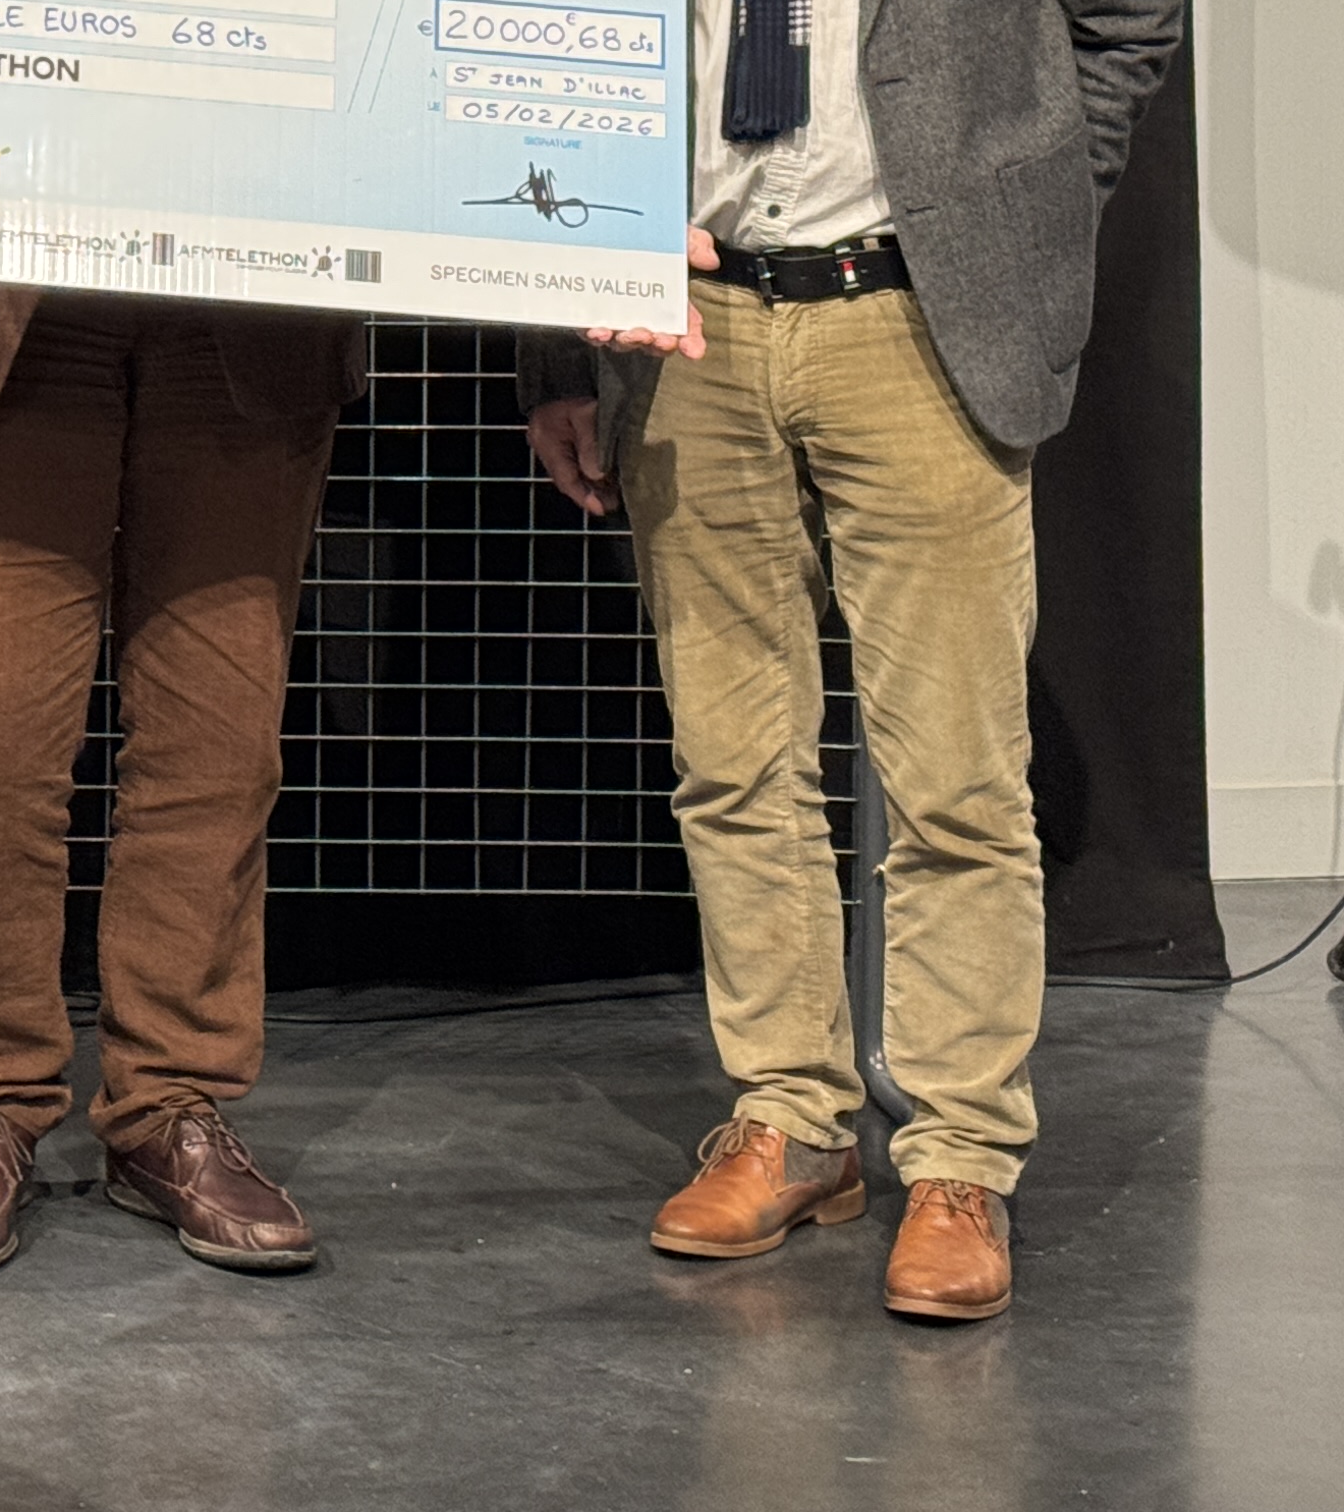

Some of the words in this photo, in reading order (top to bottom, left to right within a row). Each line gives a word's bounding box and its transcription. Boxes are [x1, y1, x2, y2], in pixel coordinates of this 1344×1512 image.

[44, 7, 138, 39] EUROS
[172, 17, 216, 47] 68
[227, 26, 268, 51] cts
[489, 73, 542, 89] JEAN
[463, 102, 653, 136] 05/02/2026
[430, 265, 529, 288] SPECIMEN
[534, 272, 586, 292] SANS
[591, 278, 665, 299] VALEUR
